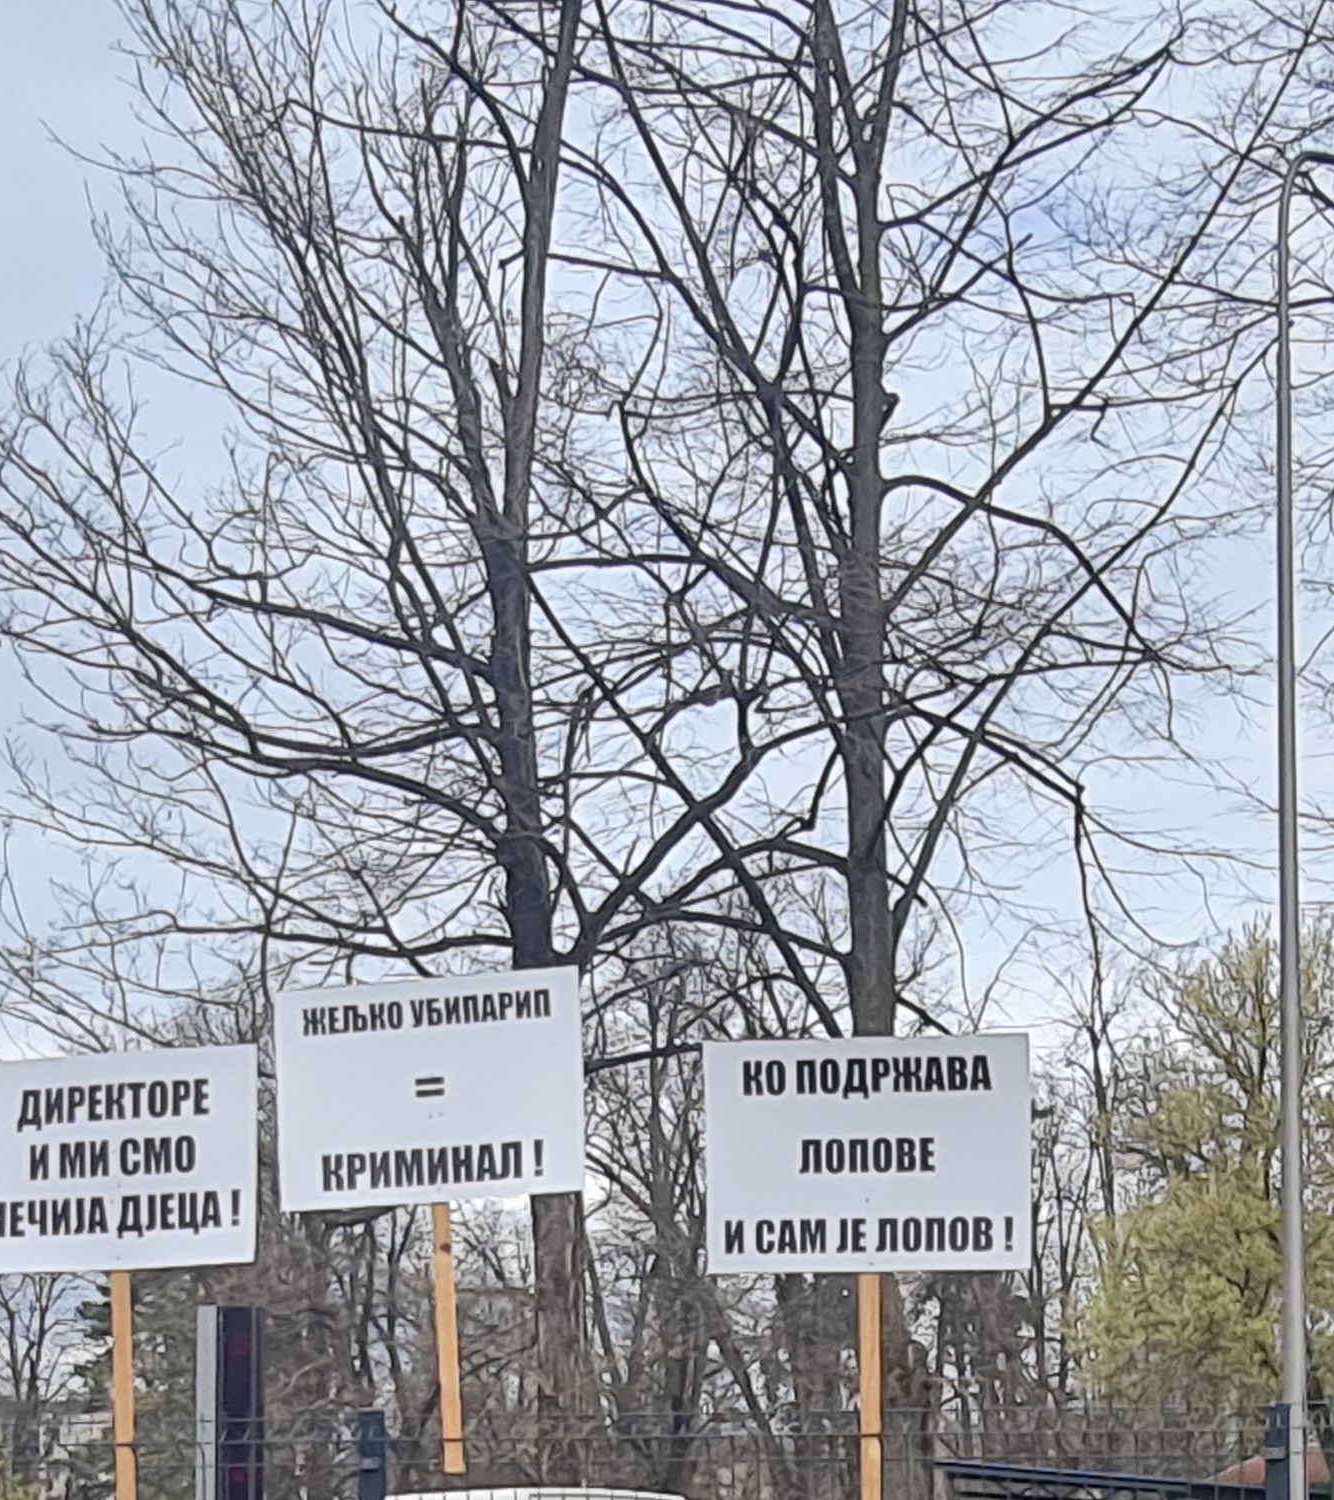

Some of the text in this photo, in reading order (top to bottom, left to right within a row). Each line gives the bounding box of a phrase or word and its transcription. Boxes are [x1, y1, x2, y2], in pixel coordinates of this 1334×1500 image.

[303, 989, 551, 1036] ЖЕЉКО УБИПАРИП
[415, 1077, 444, 1098] =
[742, 1054, 992, 1100] КО ПОДРЖАВА
[17, 1078, 209, 1132] ДИРЕКТОРЕ
[30, 1135, 195, 1181] И МИ СМО
[322, 1141, 522, 1191] КРИМИНАЛ
[799, 1137, 935, 1174] ЛОПОВЕ
[116, 1191, 221, 1239] ДЈЕЦА
[724, 1220, 744, 1254] И
[755, 1218, 827, 1254] САМ
[836, 1218, 867, 1253] ЈЕ
[875, 1216, 993, 1252] ЛОПОВ
